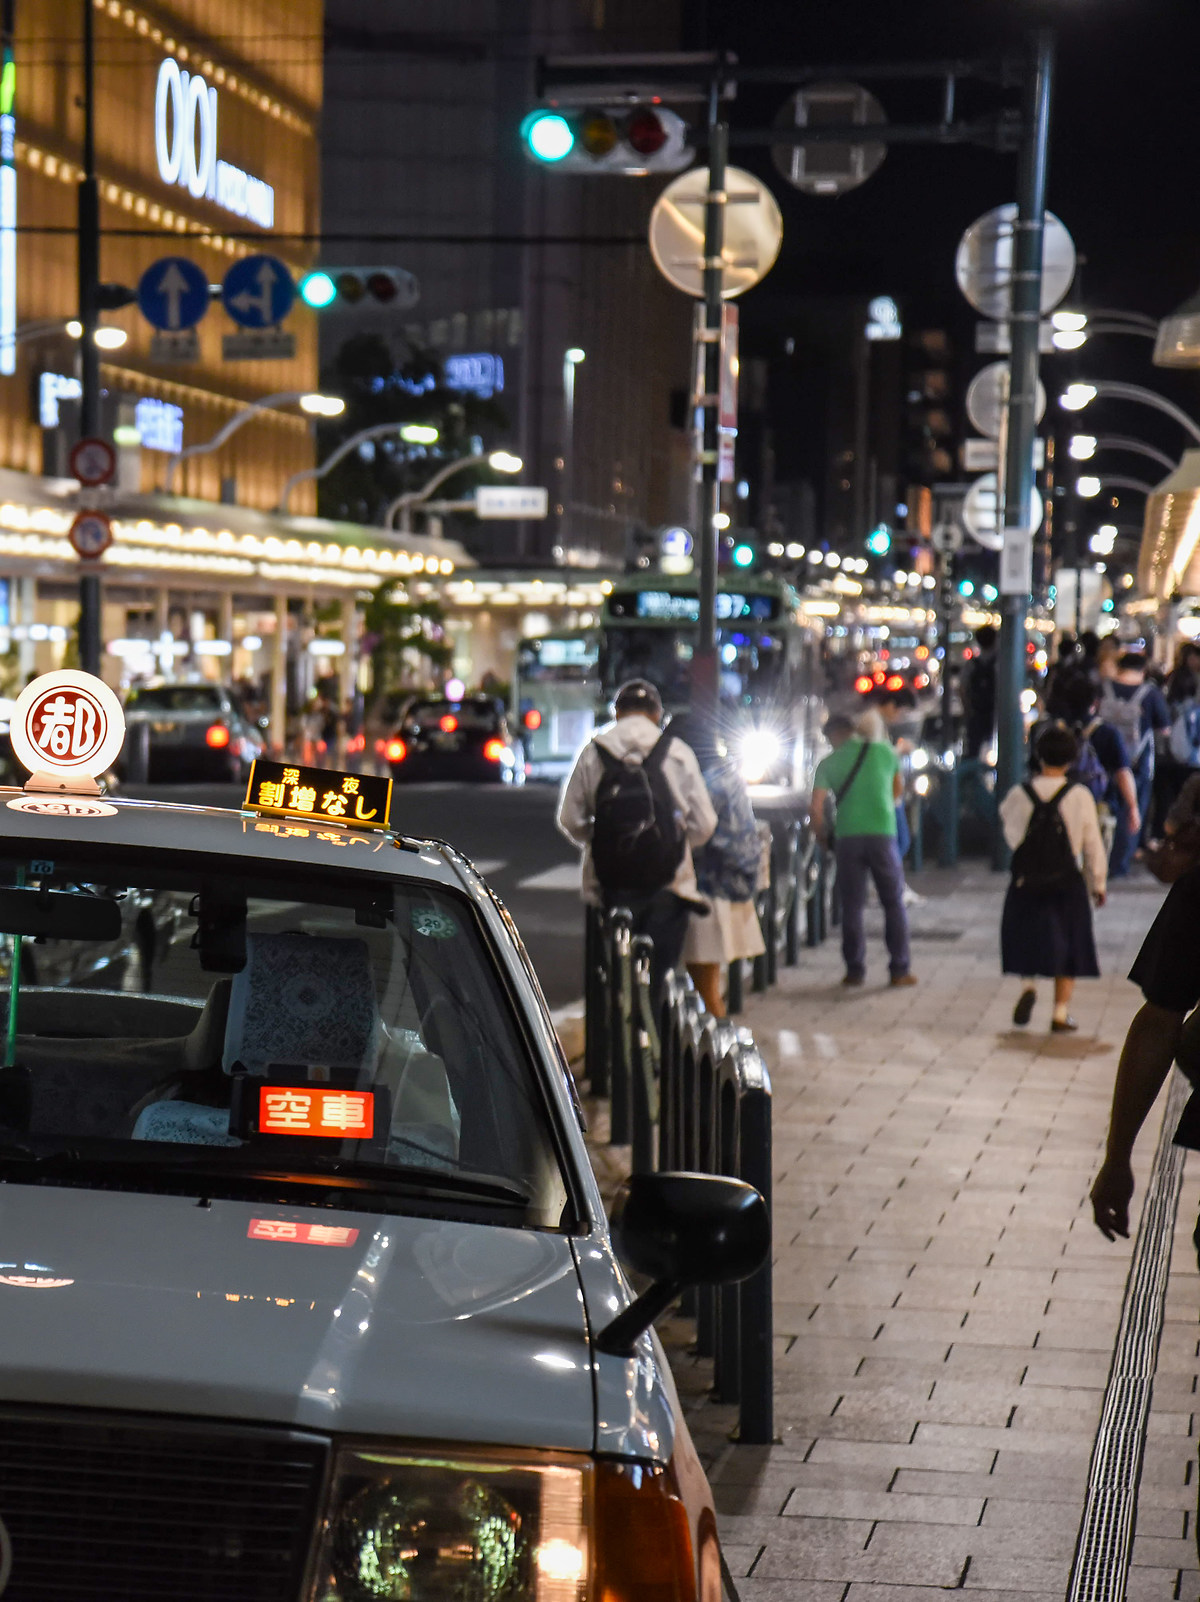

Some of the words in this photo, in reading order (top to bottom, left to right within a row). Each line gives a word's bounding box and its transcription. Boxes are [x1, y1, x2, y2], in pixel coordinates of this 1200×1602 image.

[38, 696, 96, 757] 都
[258, 781, 378, 820] 割増なし
[265, 1091, 366, 1131] 空車
